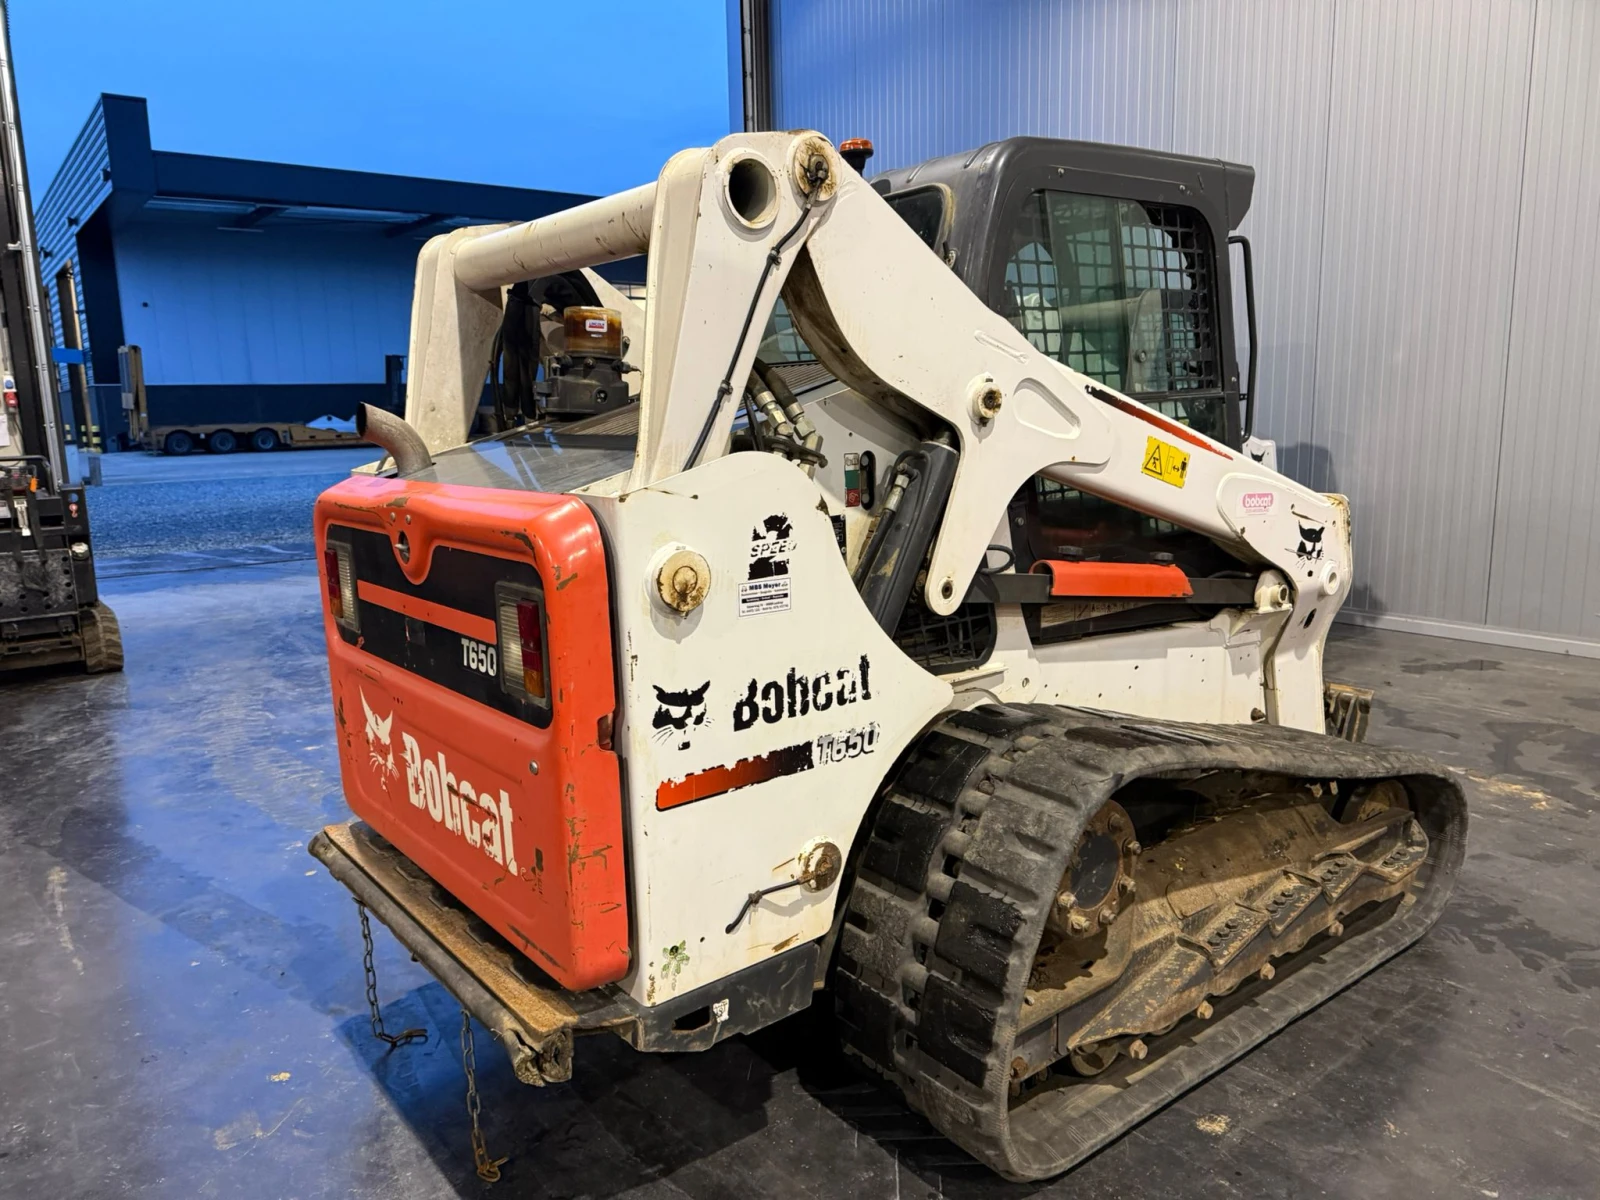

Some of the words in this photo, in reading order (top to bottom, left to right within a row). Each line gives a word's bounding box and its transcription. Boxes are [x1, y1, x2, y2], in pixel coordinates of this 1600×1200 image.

[1245, 494, 1271, 507] bobcat
[461, 637, 497, 677] T650
[732, 653, 872, 732] Bobcat
[816, 721, 880, 765] T650
[400, 731, 518, 877] Bobcat
